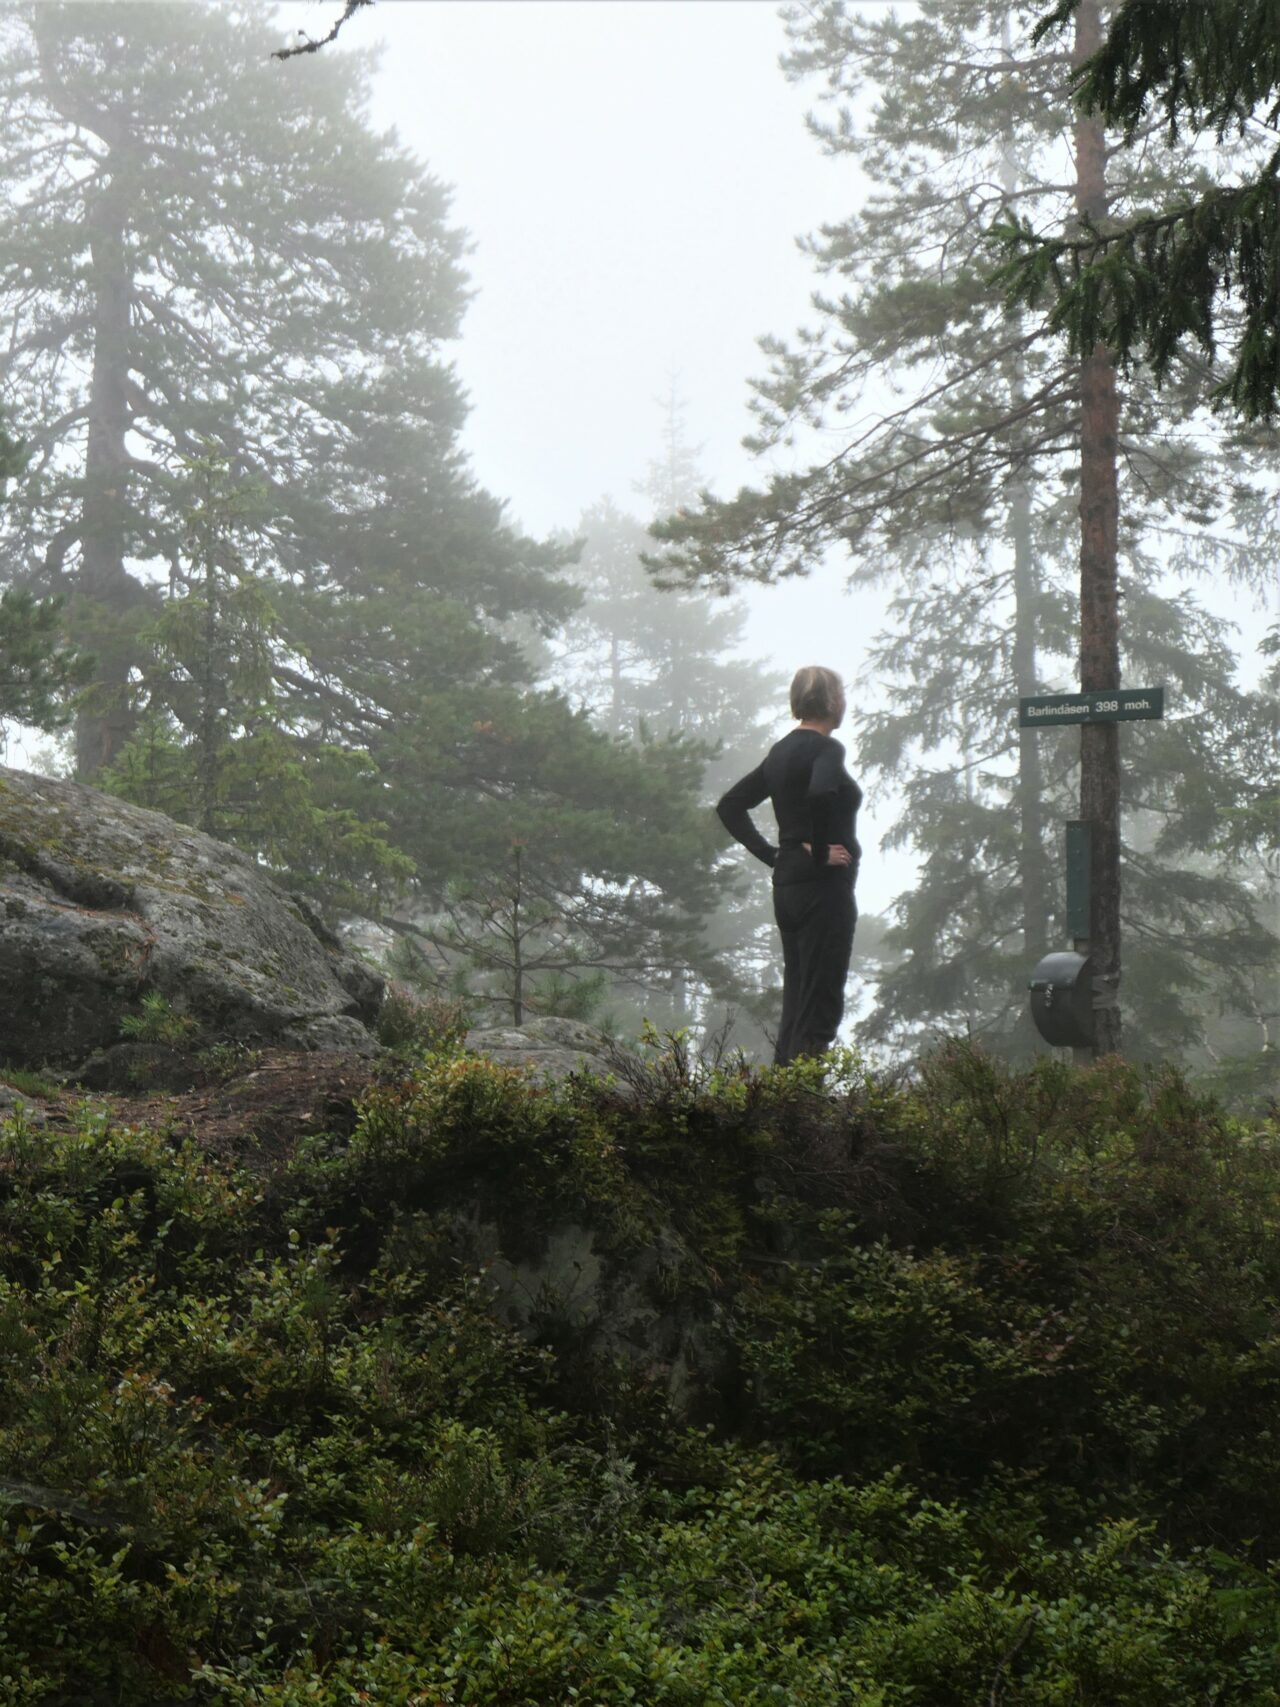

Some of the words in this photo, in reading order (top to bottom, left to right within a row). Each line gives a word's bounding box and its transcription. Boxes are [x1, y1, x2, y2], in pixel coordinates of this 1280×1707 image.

[1028, 703, 1090, 717] Barlindåsen
[1095, 700, 1118, 712] 398
[1124, 699, 1151, 710] moh.
